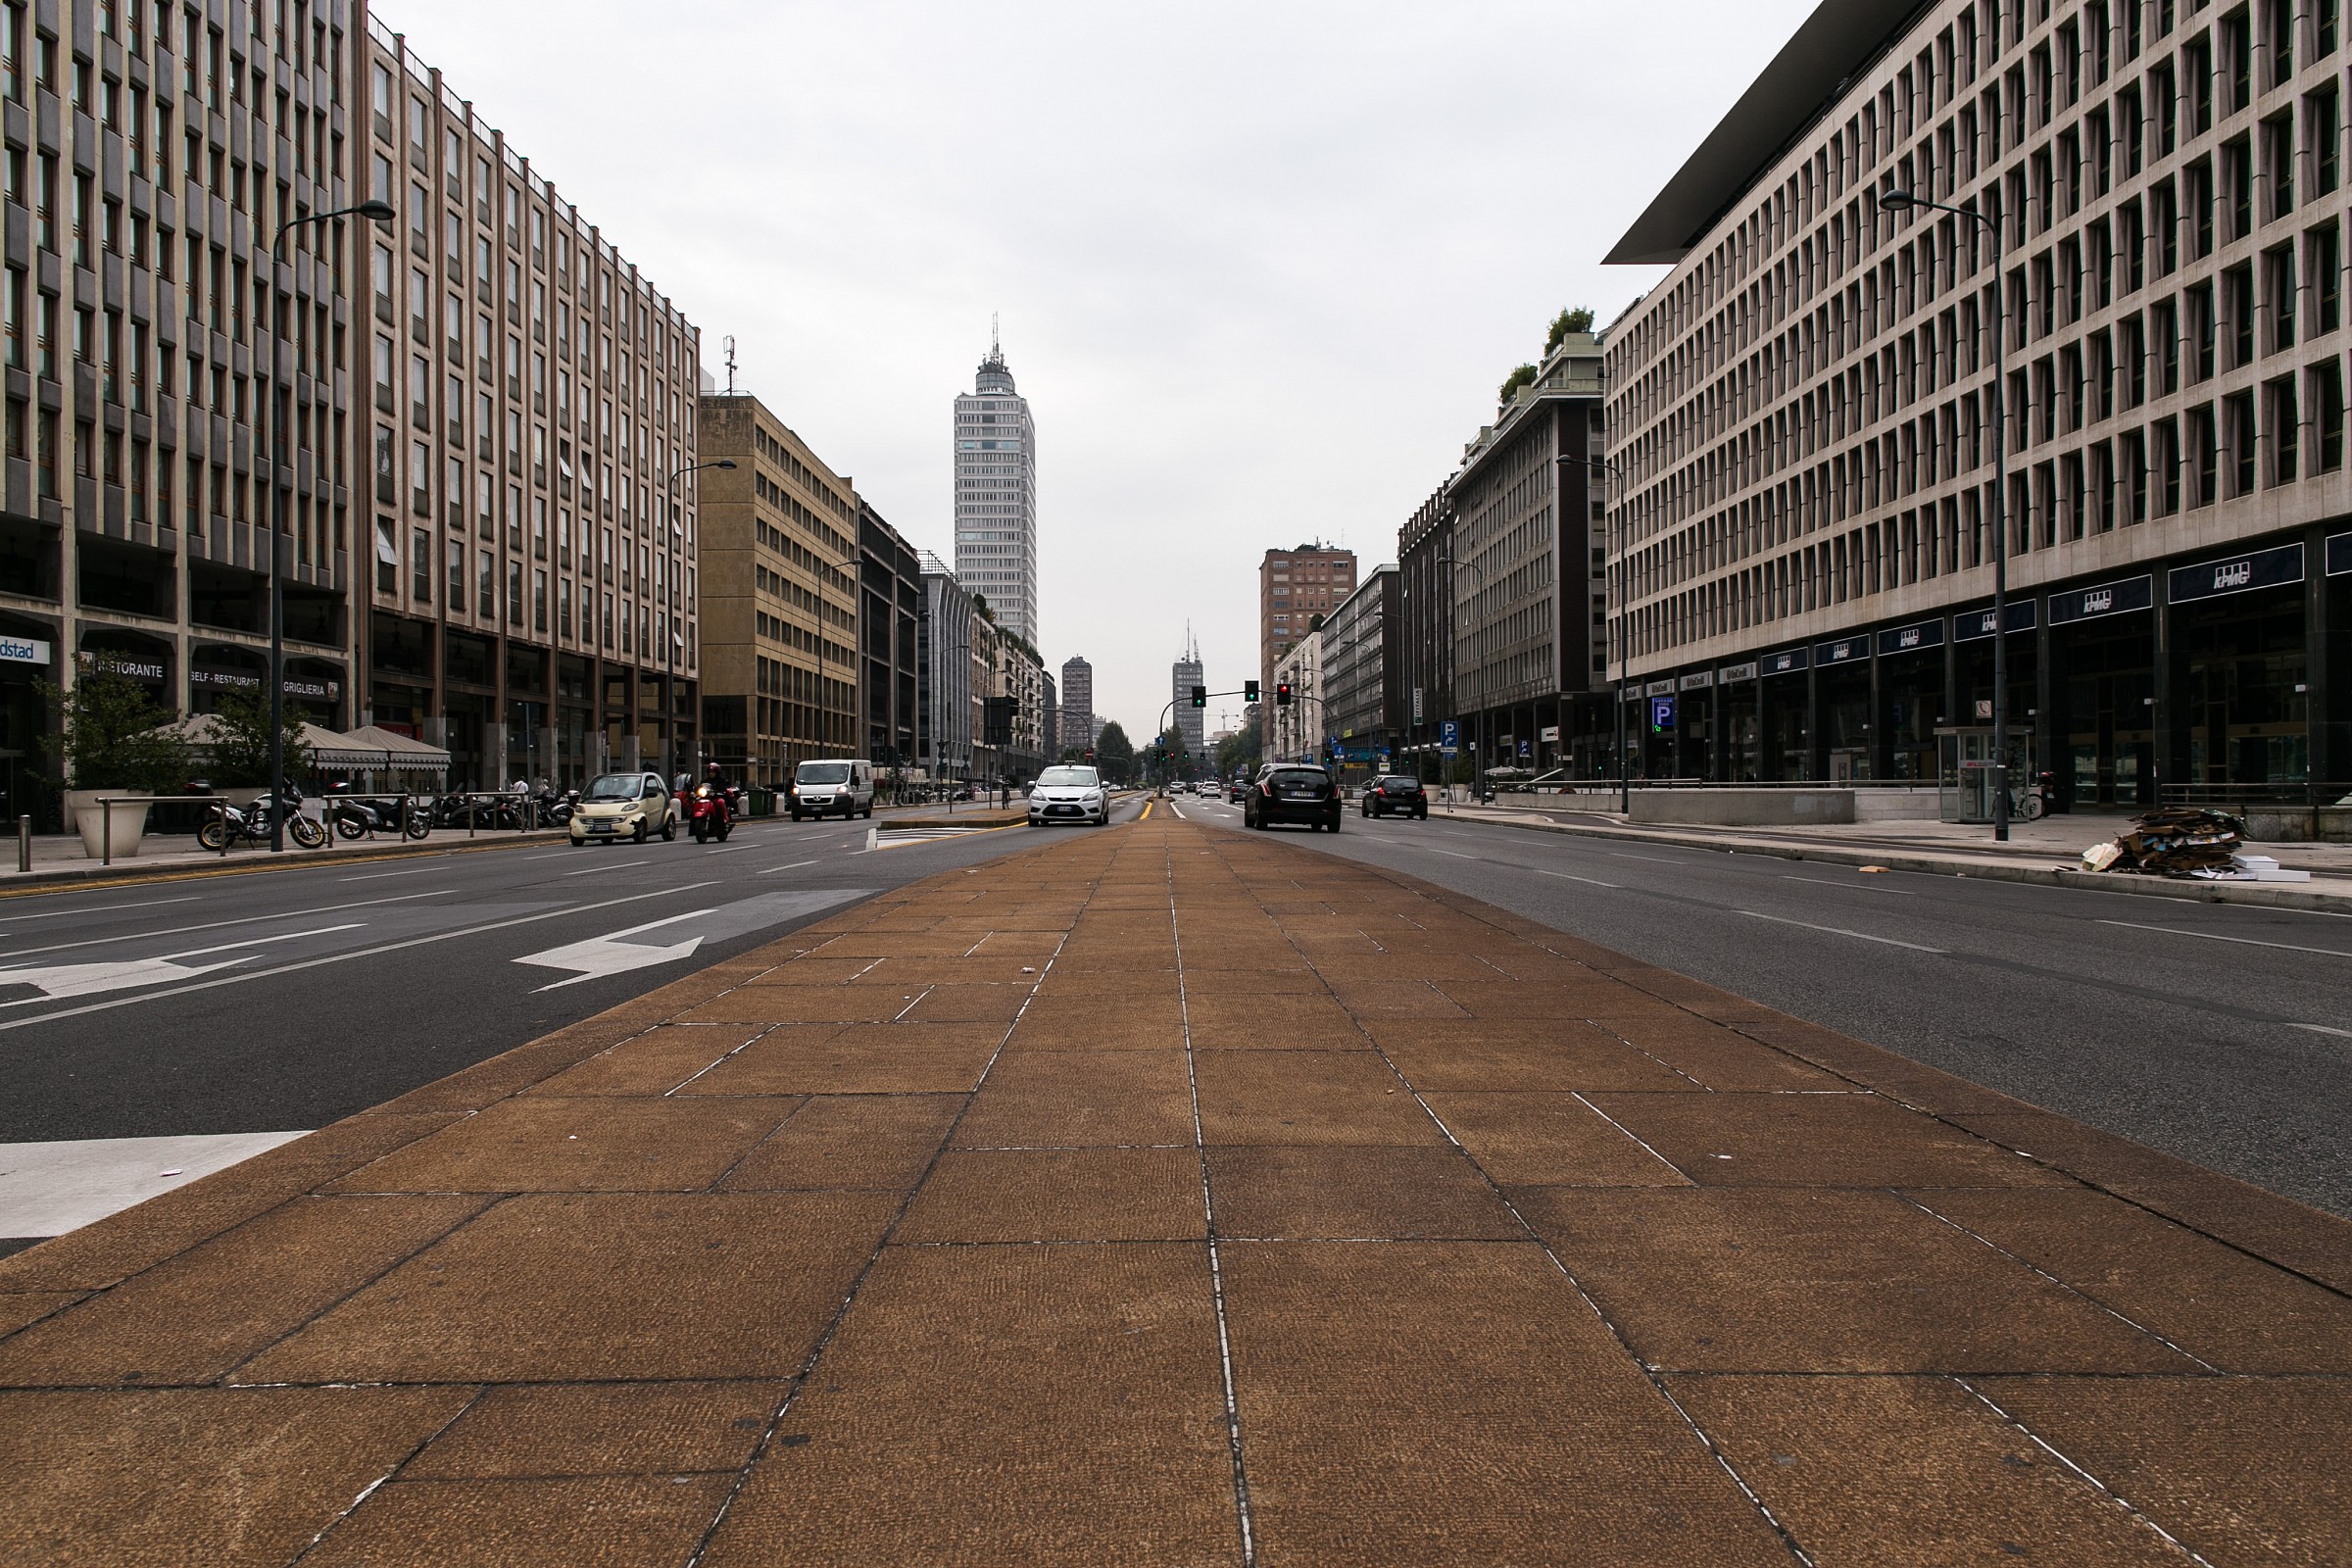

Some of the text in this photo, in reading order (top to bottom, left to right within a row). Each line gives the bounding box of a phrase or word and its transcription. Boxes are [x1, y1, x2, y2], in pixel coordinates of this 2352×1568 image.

[2213, 569, 2250, 590] KPMG
[2082, 597, 2112, 613] KPMG
[1900, 635, 1919, 647] KPMG
[0, 639, 33, 660] dstad
[190, 671, 209, 682] SELF
[283, 681, 325, 696] GRIGLIERIA
[1656, 707, 1670, 724] P
[1445, 723, 1454, 735] P
[1521, 740, 1527, 749] P
